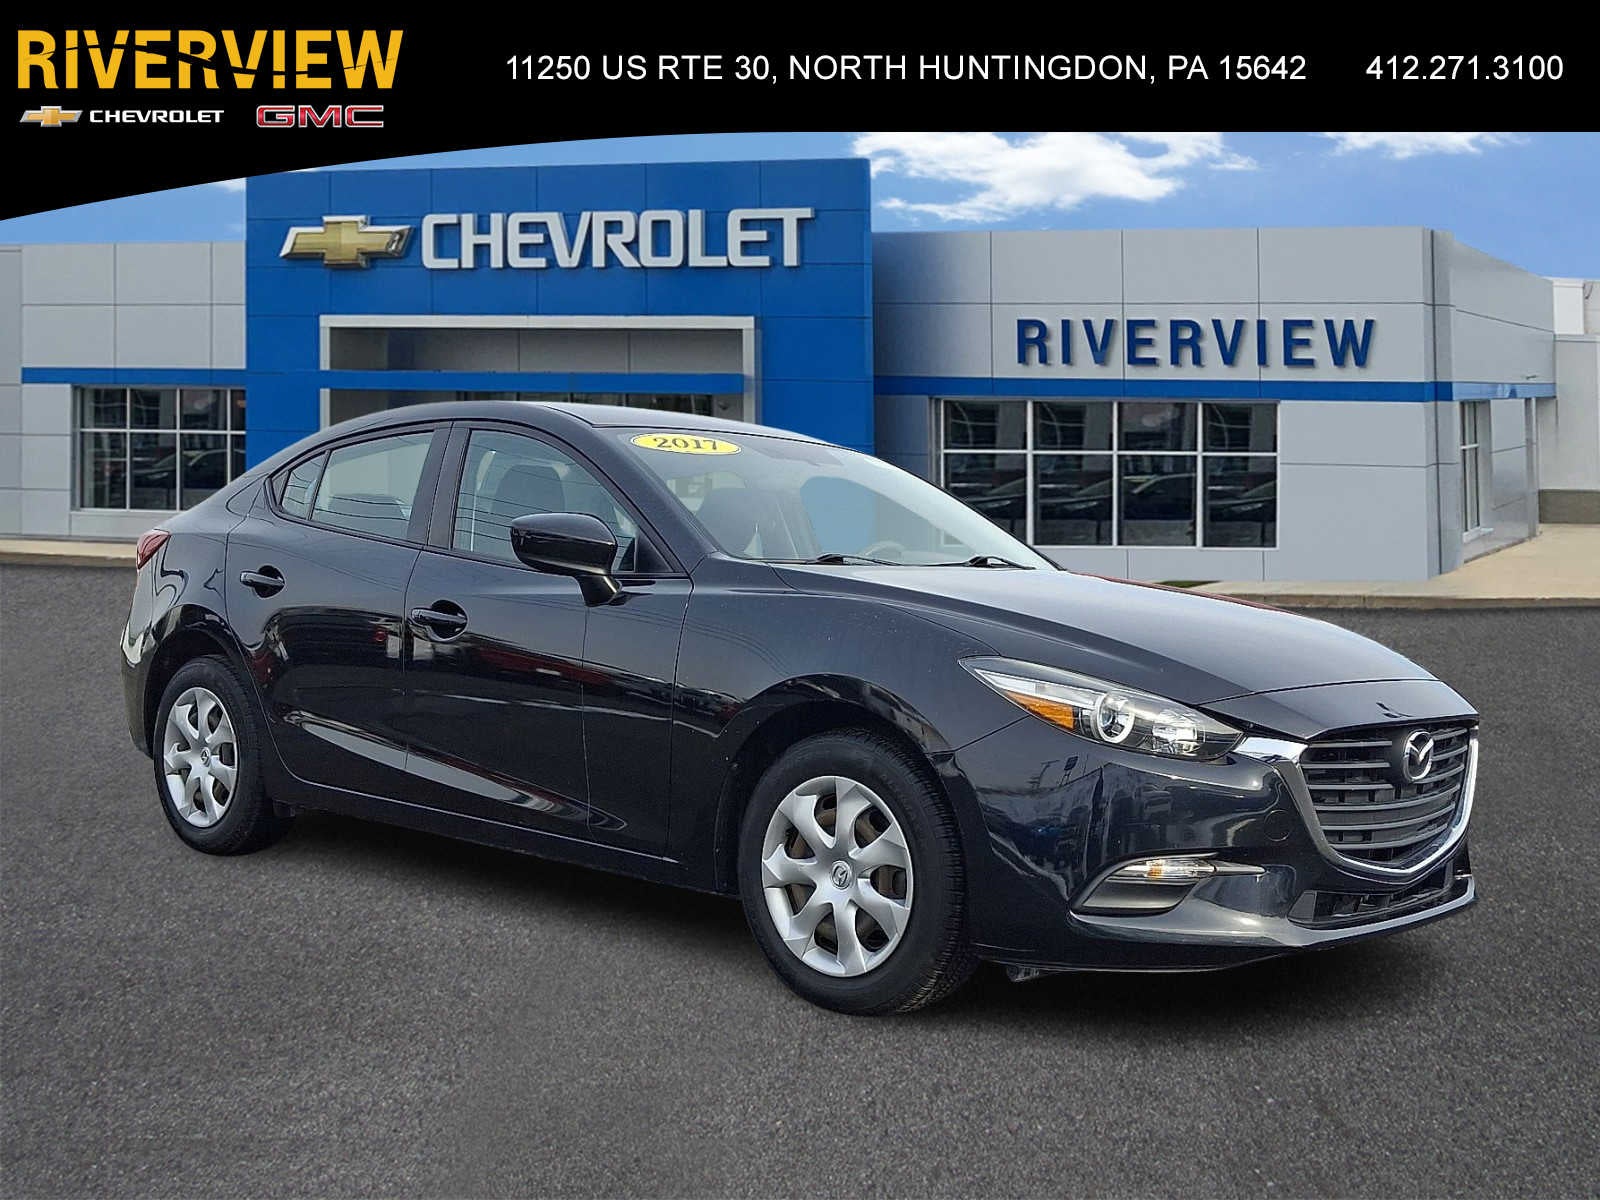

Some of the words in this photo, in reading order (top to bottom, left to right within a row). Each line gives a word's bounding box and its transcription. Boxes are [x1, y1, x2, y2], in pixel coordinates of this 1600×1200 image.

[421, 207, 813, 270] CHEVROLET
[1016, 317, 1376, 368] RIVERVIEW
[653, 437, 718, 451] 2017
